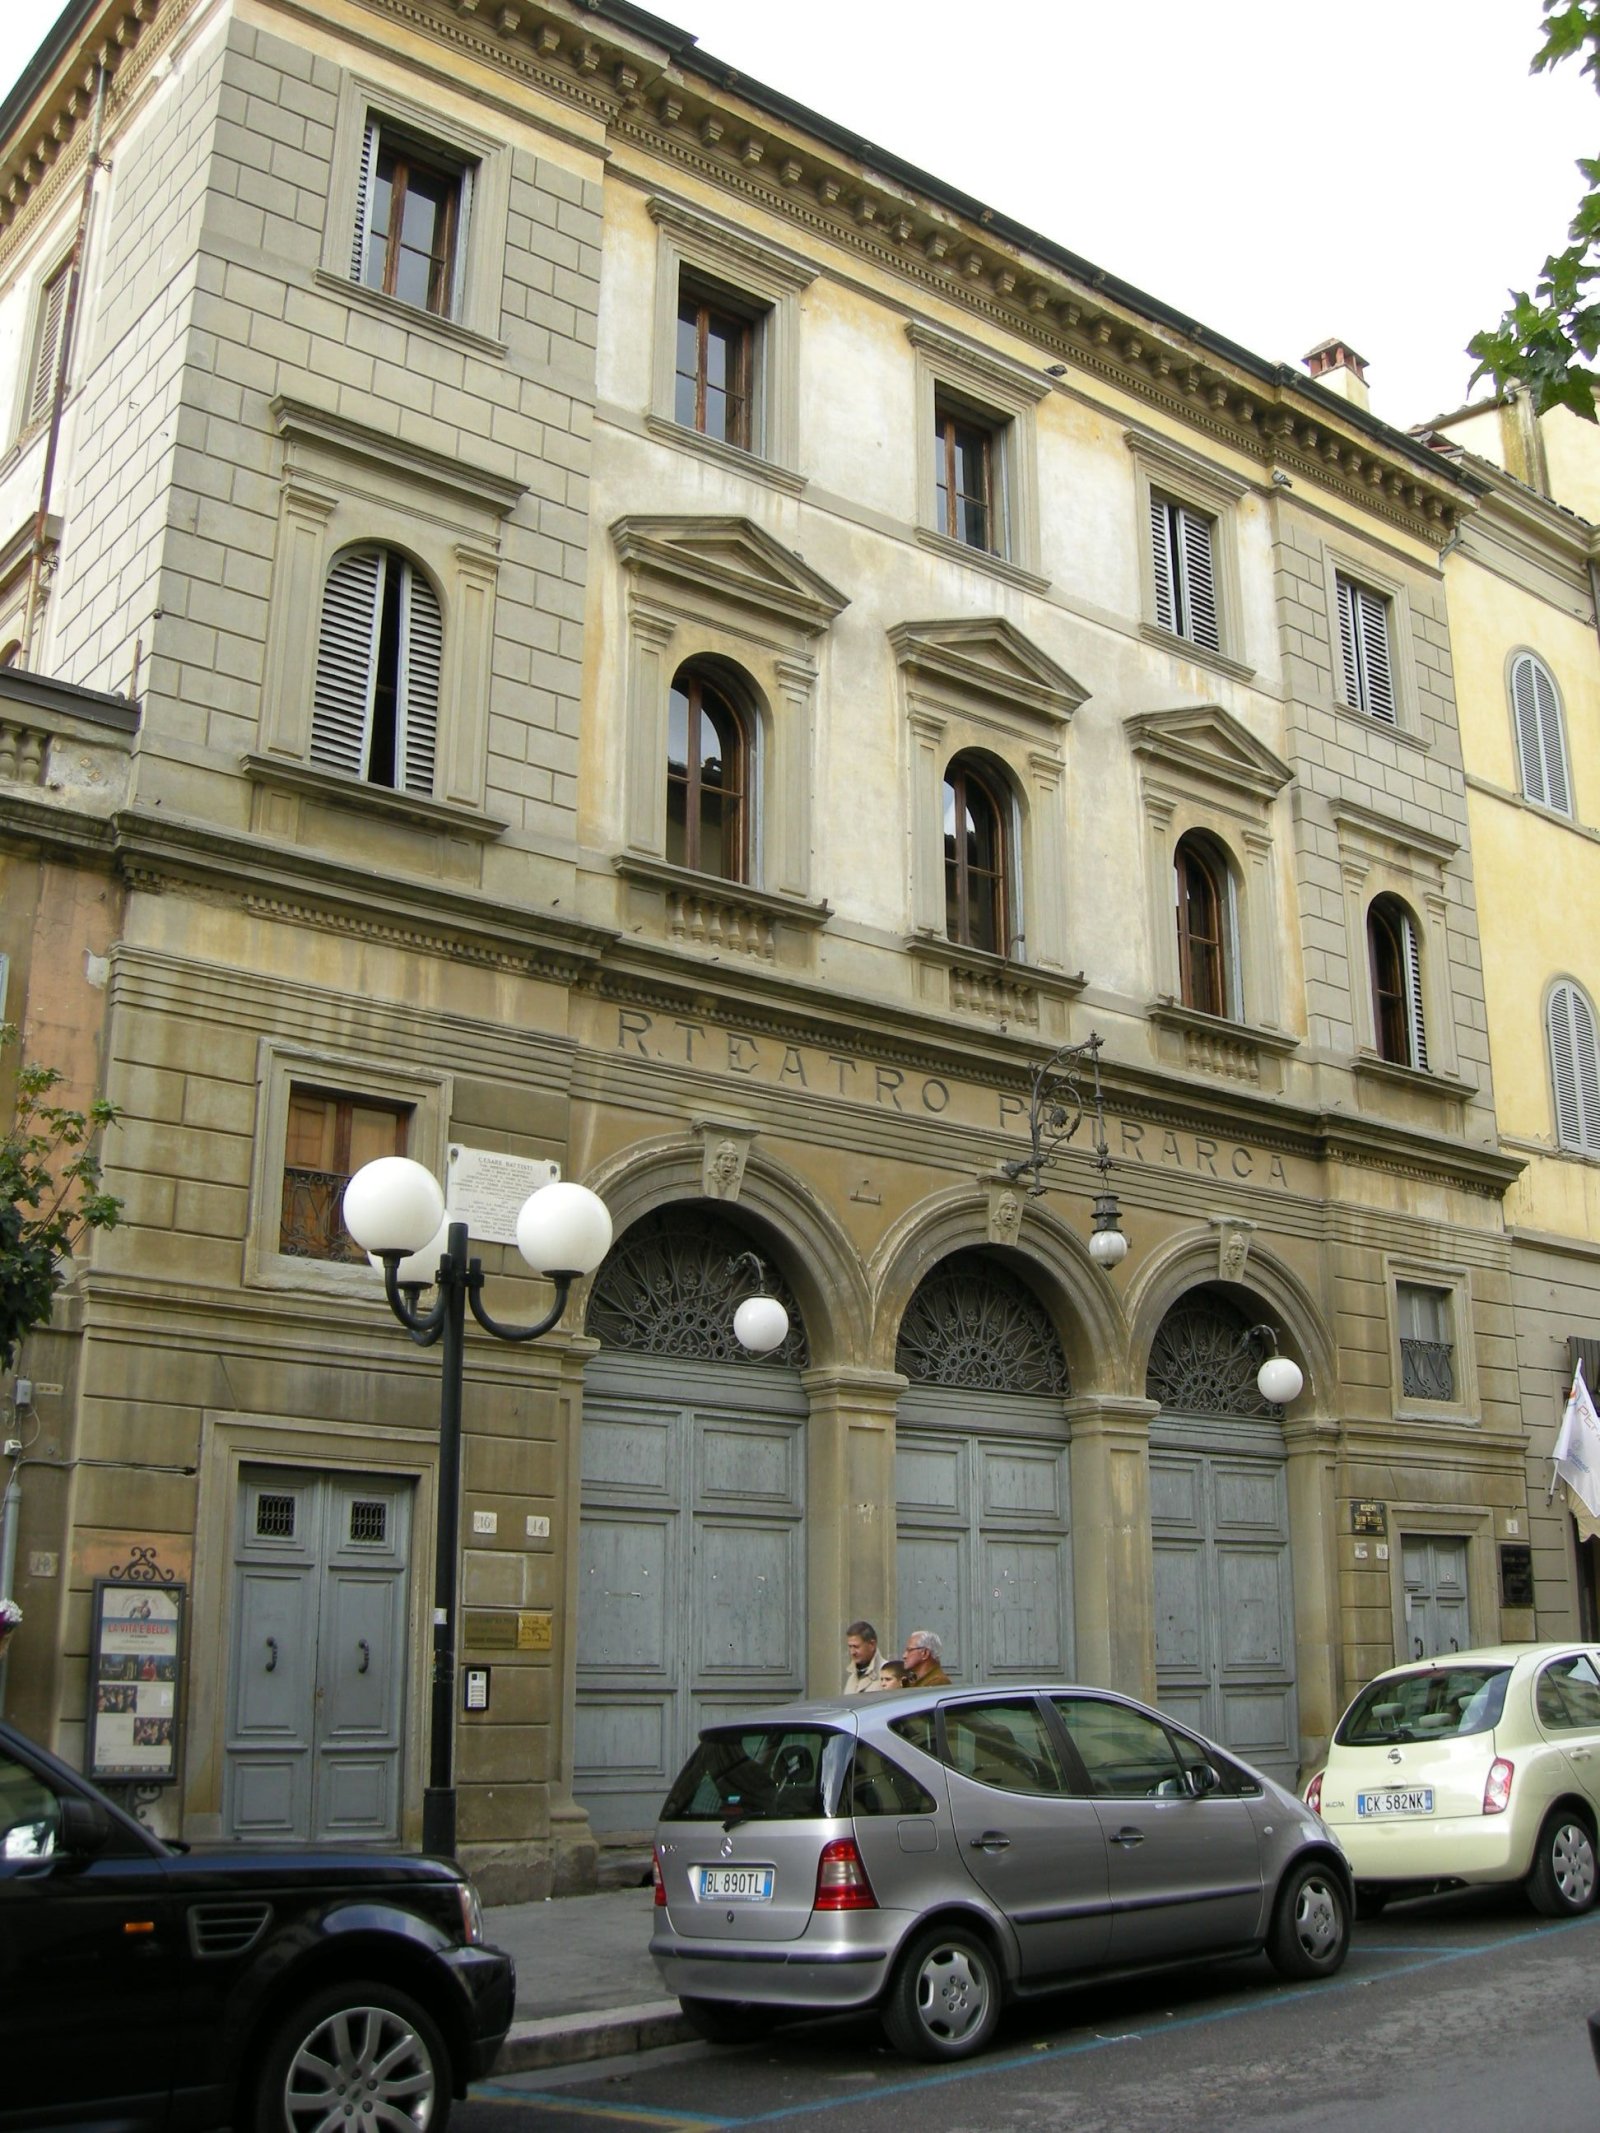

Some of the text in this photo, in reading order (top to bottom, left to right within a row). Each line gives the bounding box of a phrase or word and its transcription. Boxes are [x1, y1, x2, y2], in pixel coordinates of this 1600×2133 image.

[998, 1092, 1288, 1188] PETRARCA
[478, 1157, 533, 1171] CESARE BATTISTI
[108, 1623, 118, 1633] LA
[120, 1623, 137, 1633] VITA
[146, 1624, 170, 1635] BELLA
[1366, 1793, 1424, 1811] CK 582NK
[707, 1873, 762, 1894] BL 890TL
